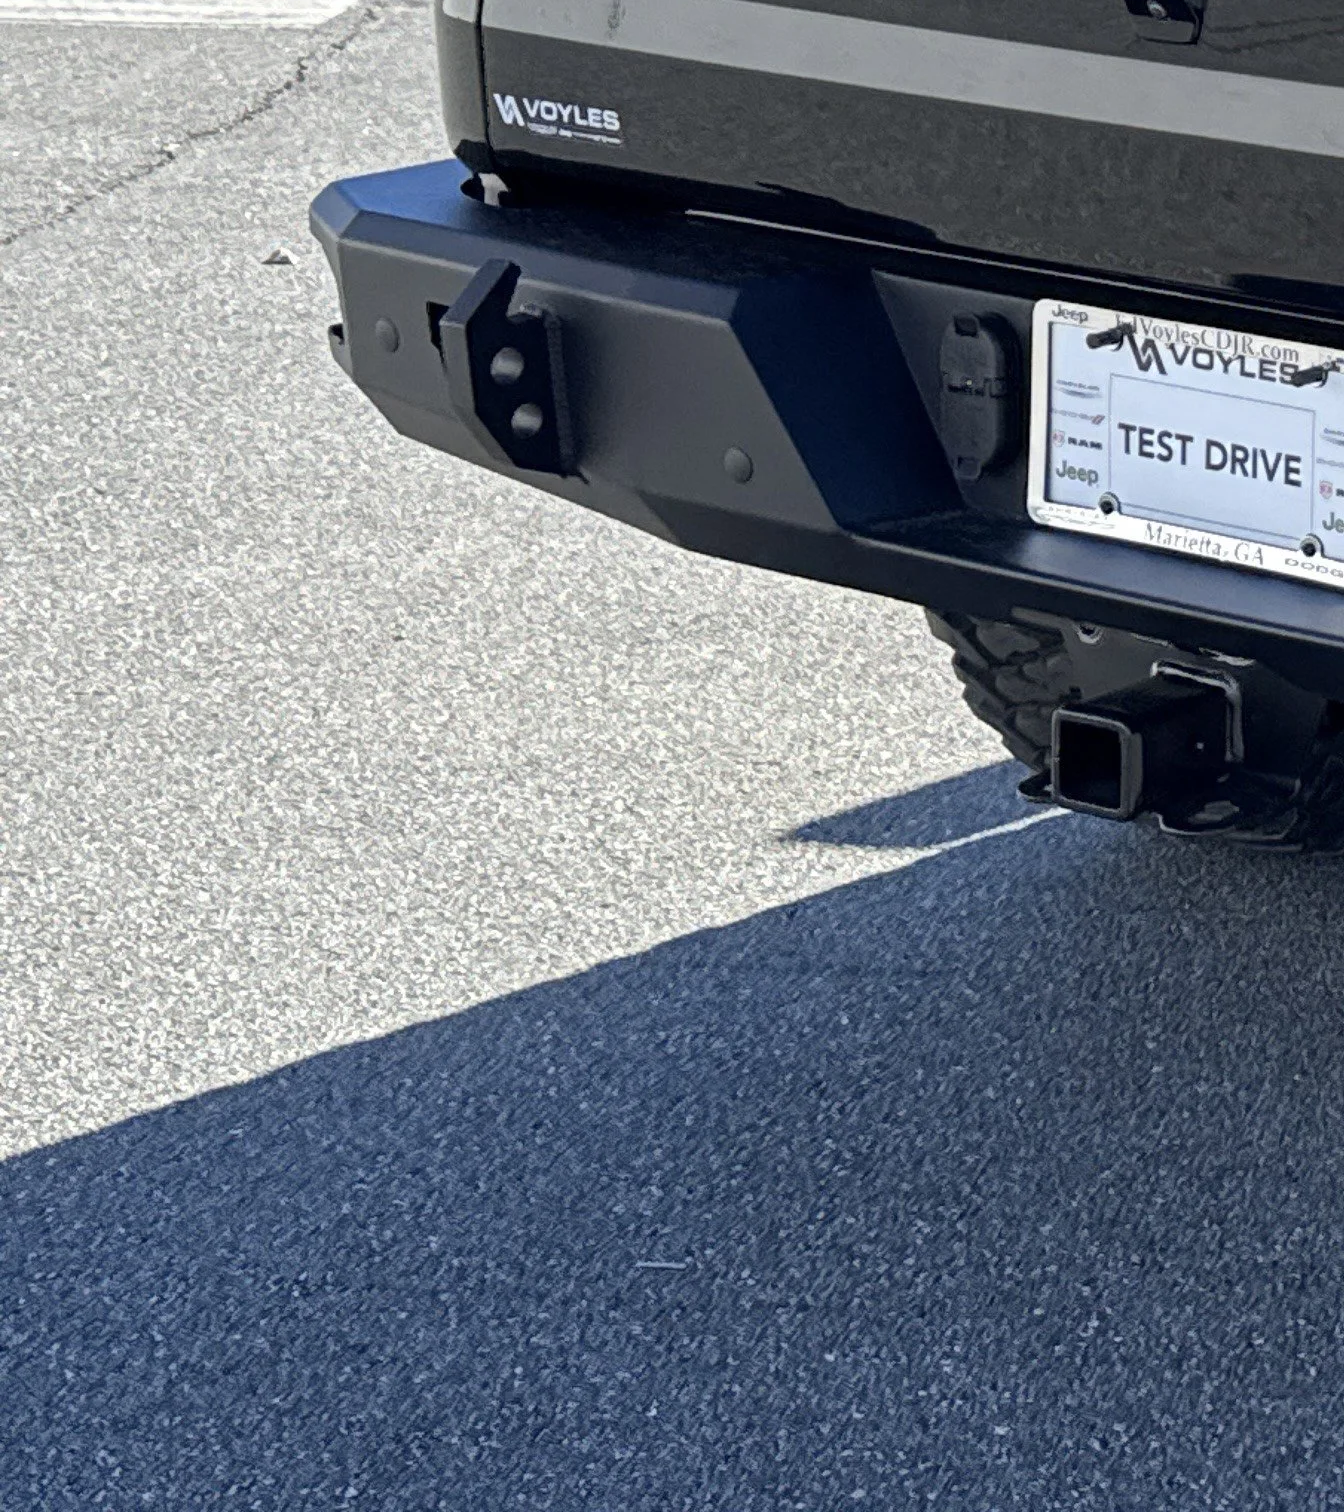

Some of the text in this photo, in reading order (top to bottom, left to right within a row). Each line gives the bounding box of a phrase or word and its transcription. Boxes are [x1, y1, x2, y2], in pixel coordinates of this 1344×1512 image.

[523, 97, 621, 131] VOYLES
[1051, 304, 1089, 324] Jeep
[1168, 342, 1299, 385] VOYLES
[1117, 422, 1302, 488] TEST DRIVE
[1056, 460, 1099, 487] Jeep
[1234, 541, 1265, 566] GA
